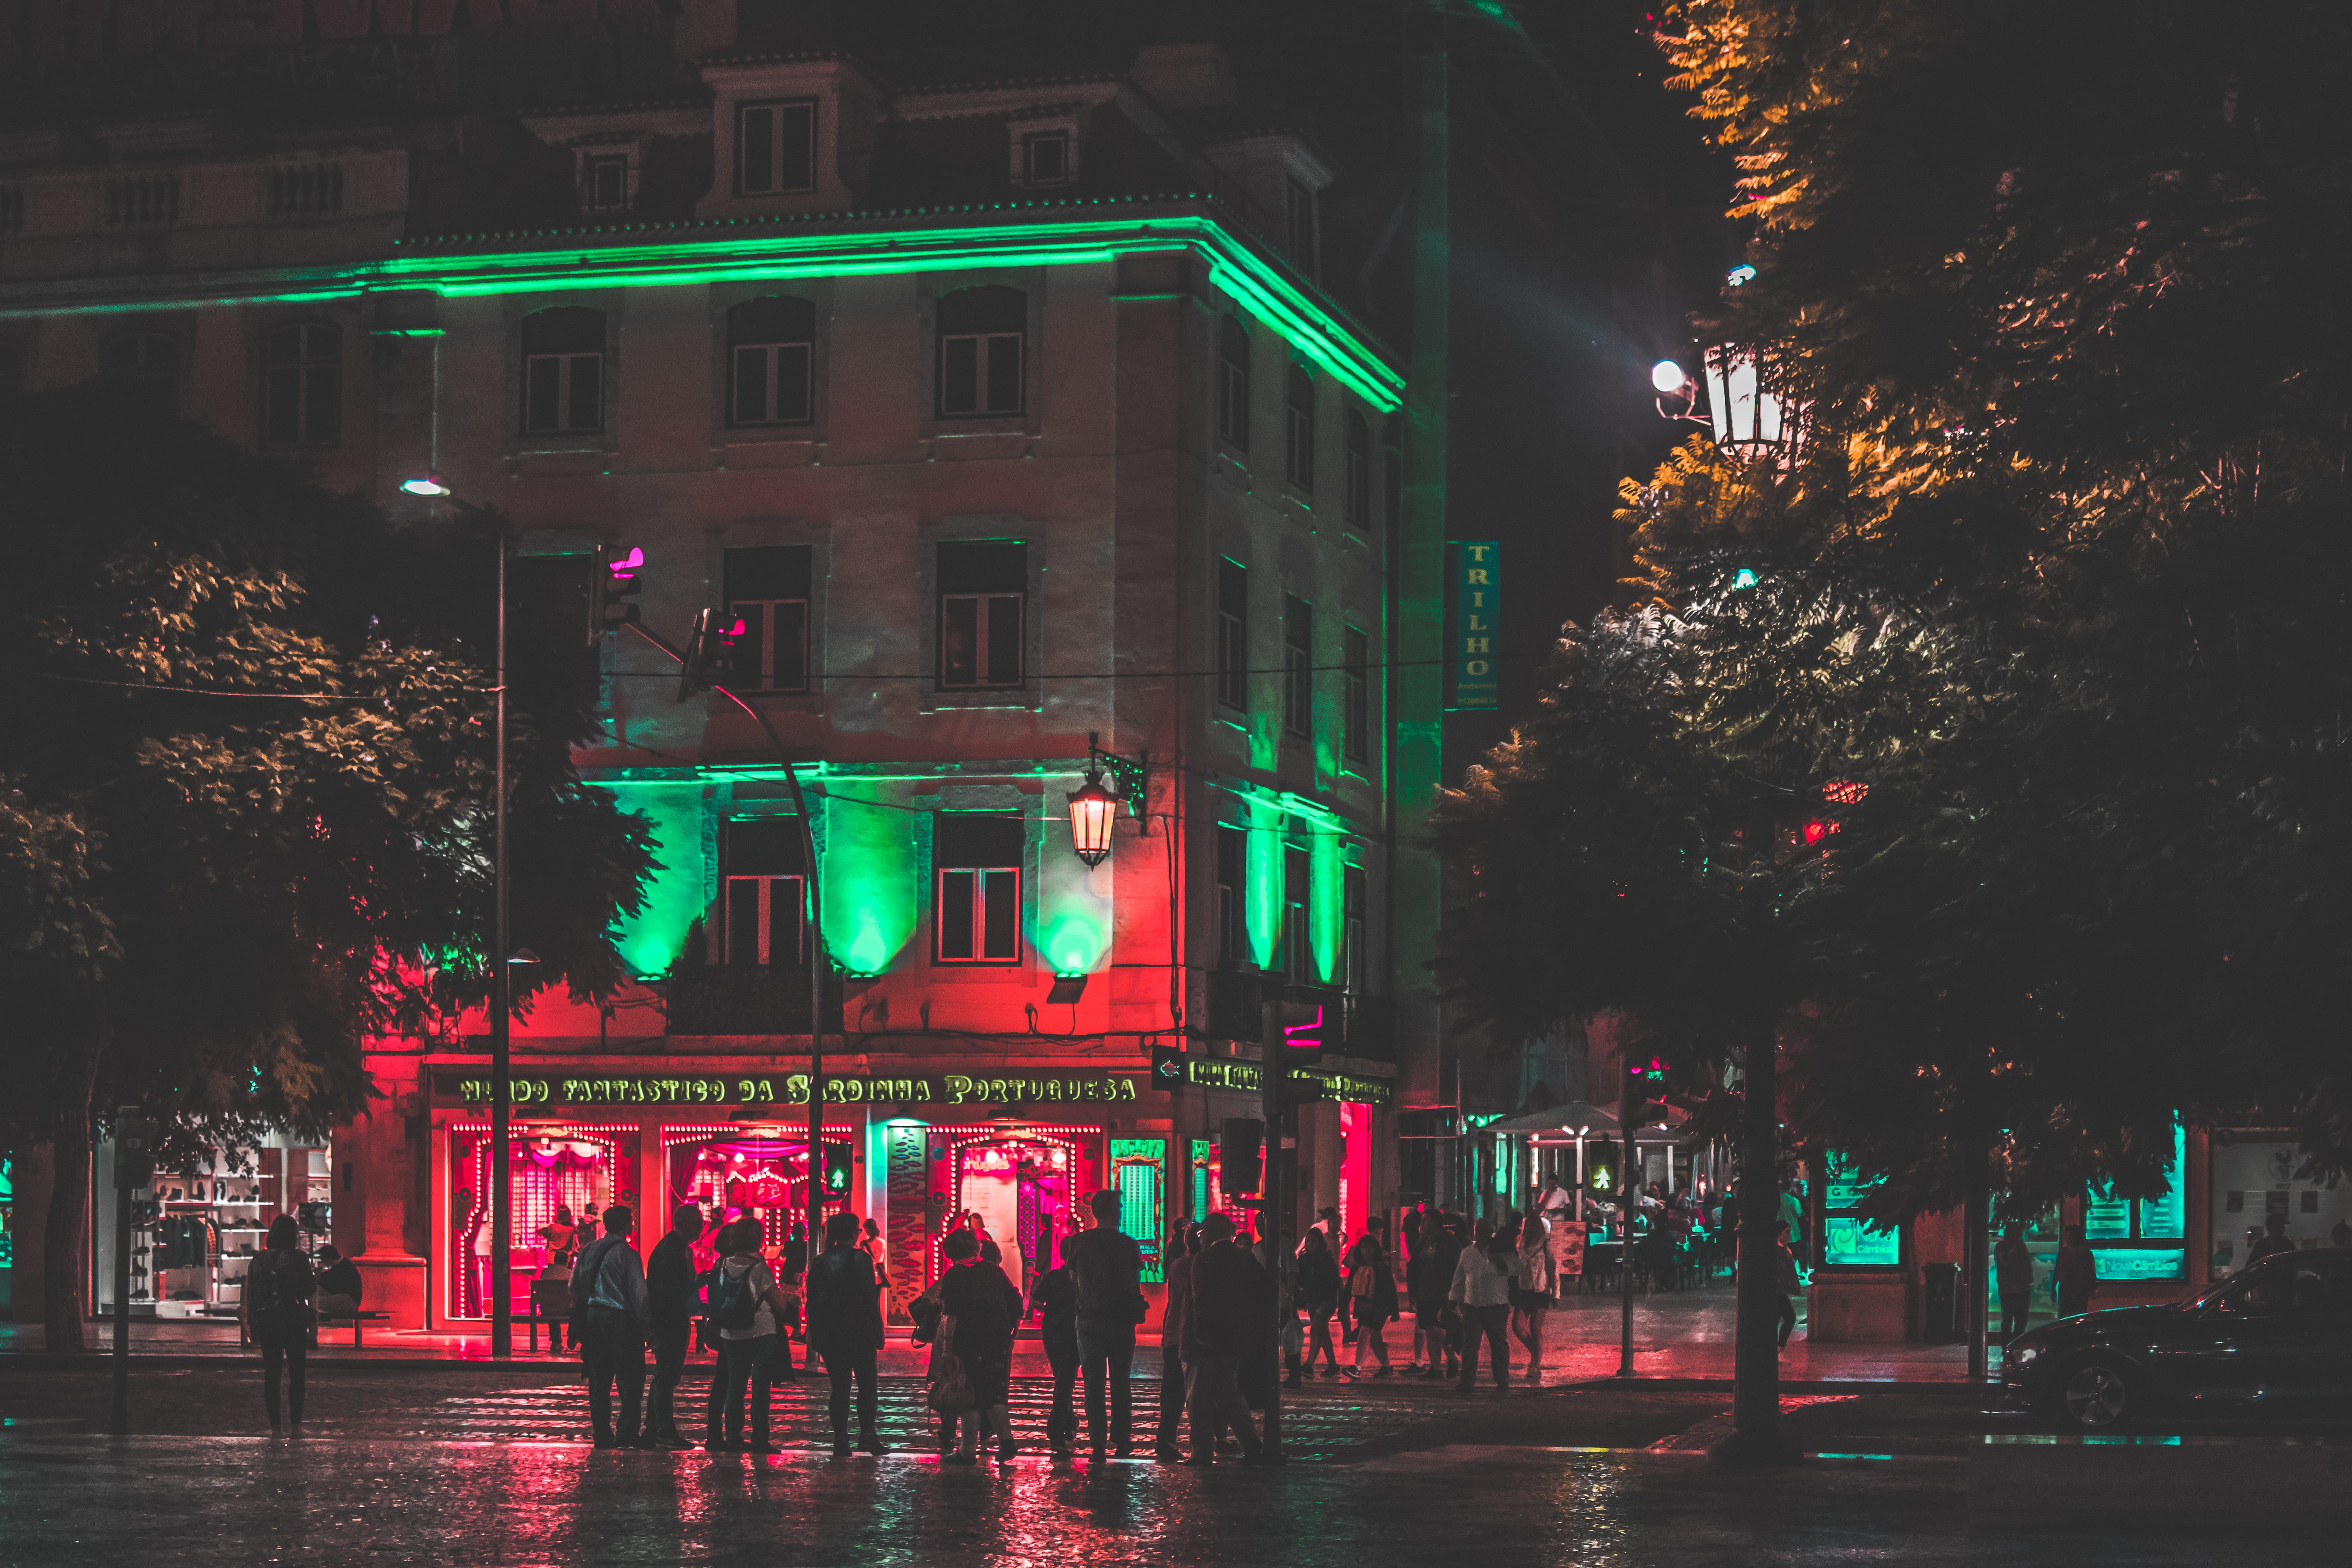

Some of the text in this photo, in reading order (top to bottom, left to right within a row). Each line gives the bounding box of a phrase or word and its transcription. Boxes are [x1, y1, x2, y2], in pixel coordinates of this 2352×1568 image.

[1466, 545, 1490, 676] TRILHO
[461, 1080, 548, 1102] MUDO
[739, 1080, 774, 1102] DA
[787, 1075, 931, 1104] SRDINHA
